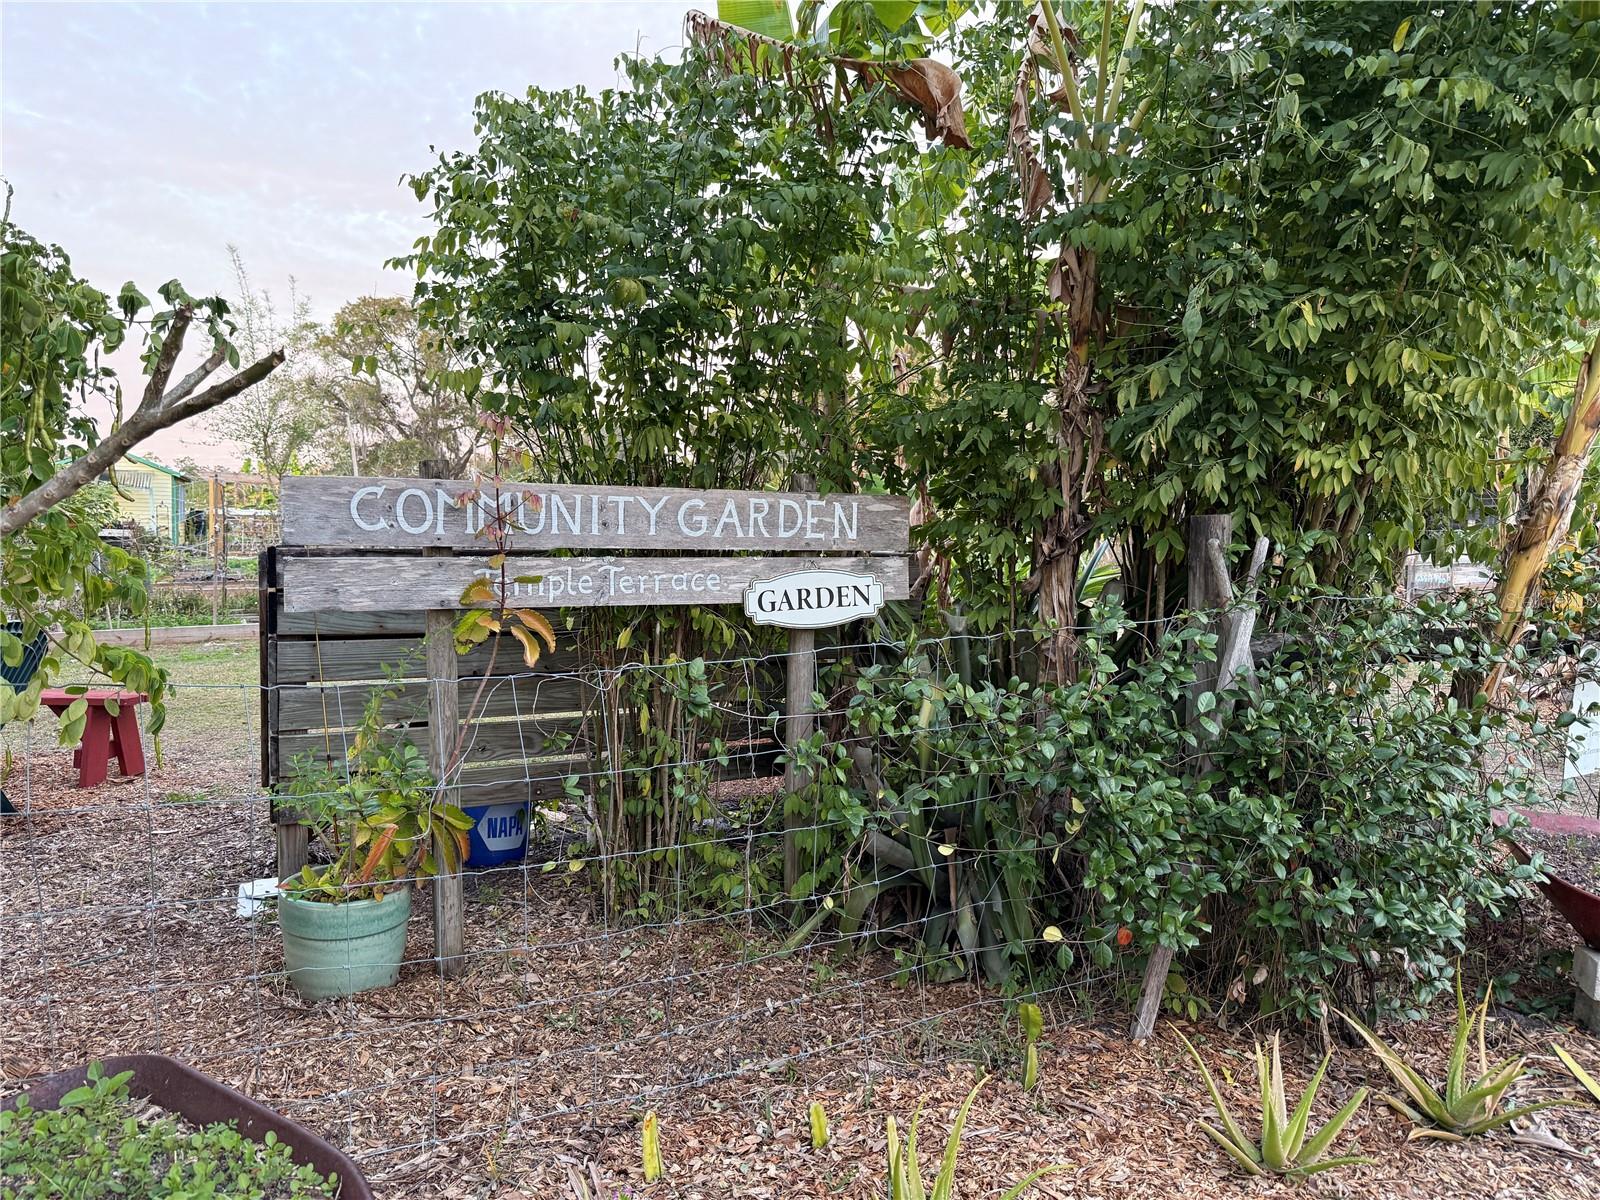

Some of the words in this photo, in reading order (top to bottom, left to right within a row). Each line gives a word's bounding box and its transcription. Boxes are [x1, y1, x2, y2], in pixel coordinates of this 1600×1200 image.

[350, 484, 671, 536] COMMUNITY
[677, 497, 858, 540] GARDEN
[598, 565, 721, 596] Terrace
[757, 584, 872, 613] GARDEN
[487, 815, 523, 838] NAPA
